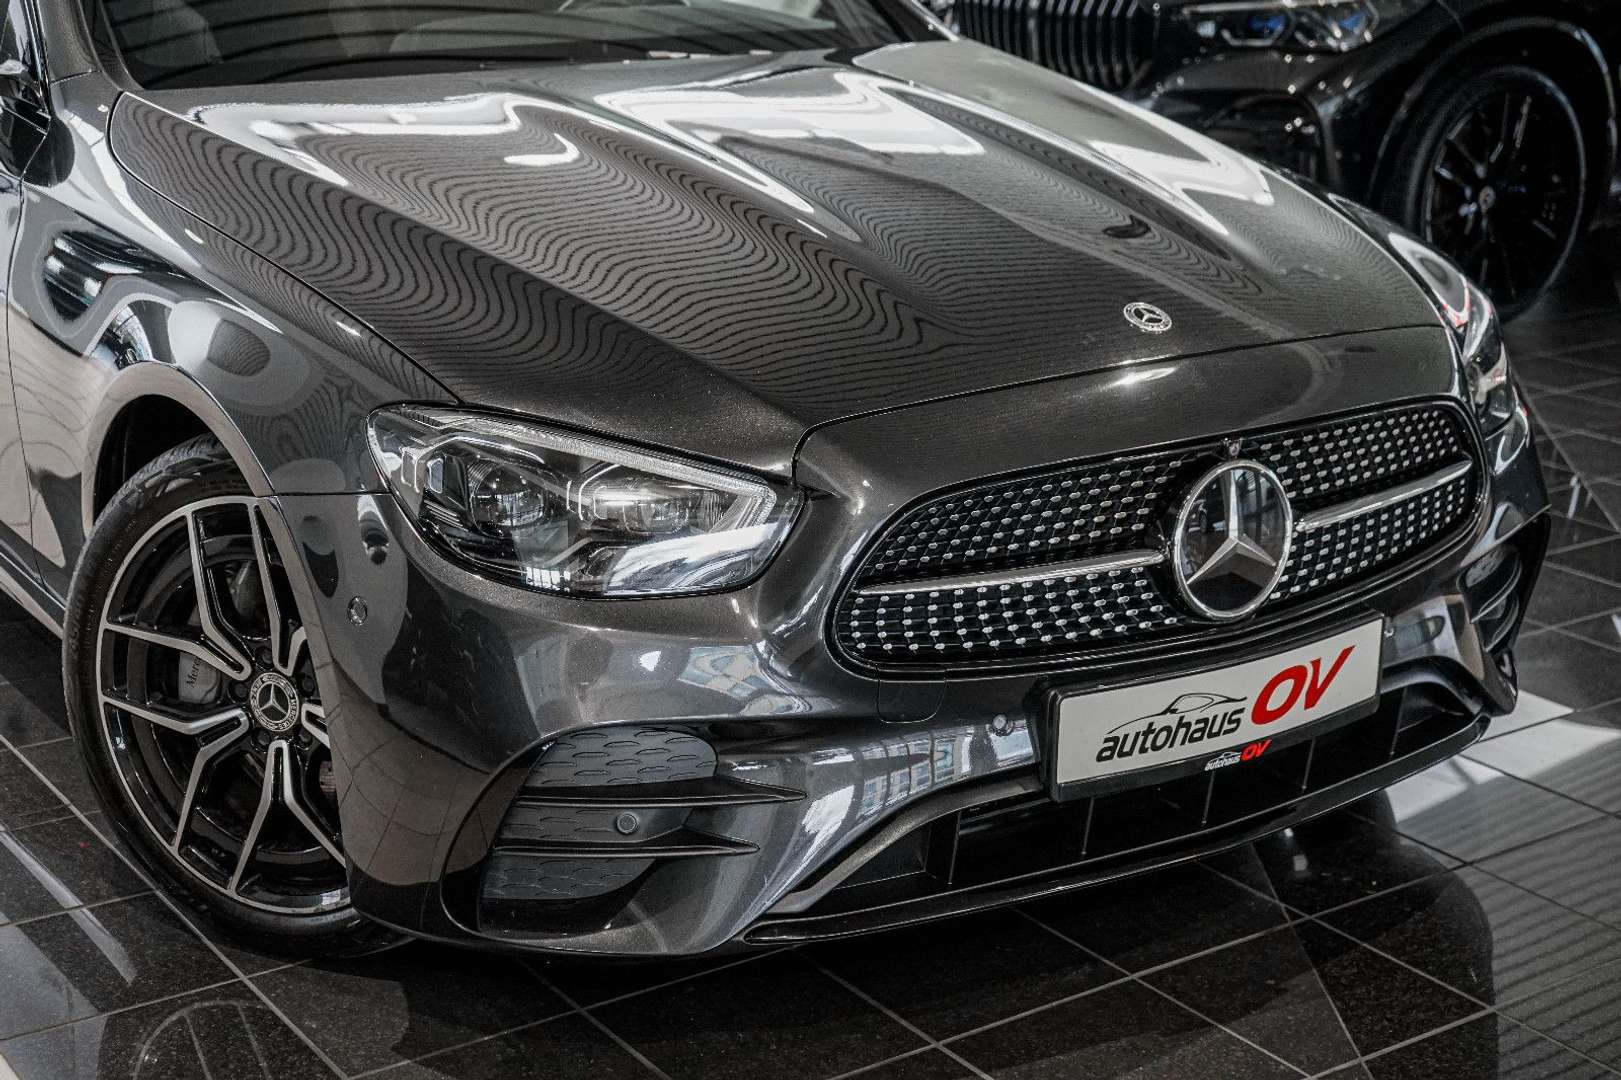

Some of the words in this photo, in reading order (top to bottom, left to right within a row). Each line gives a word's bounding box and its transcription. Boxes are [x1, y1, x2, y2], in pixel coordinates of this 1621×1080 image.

[1096, 707, 1245, 763] autohaus
[1251, 645, 1355, 724] OV
[1205, 754, 1241, 771] autohaus
[1241, 739, 1271, 761] OV
